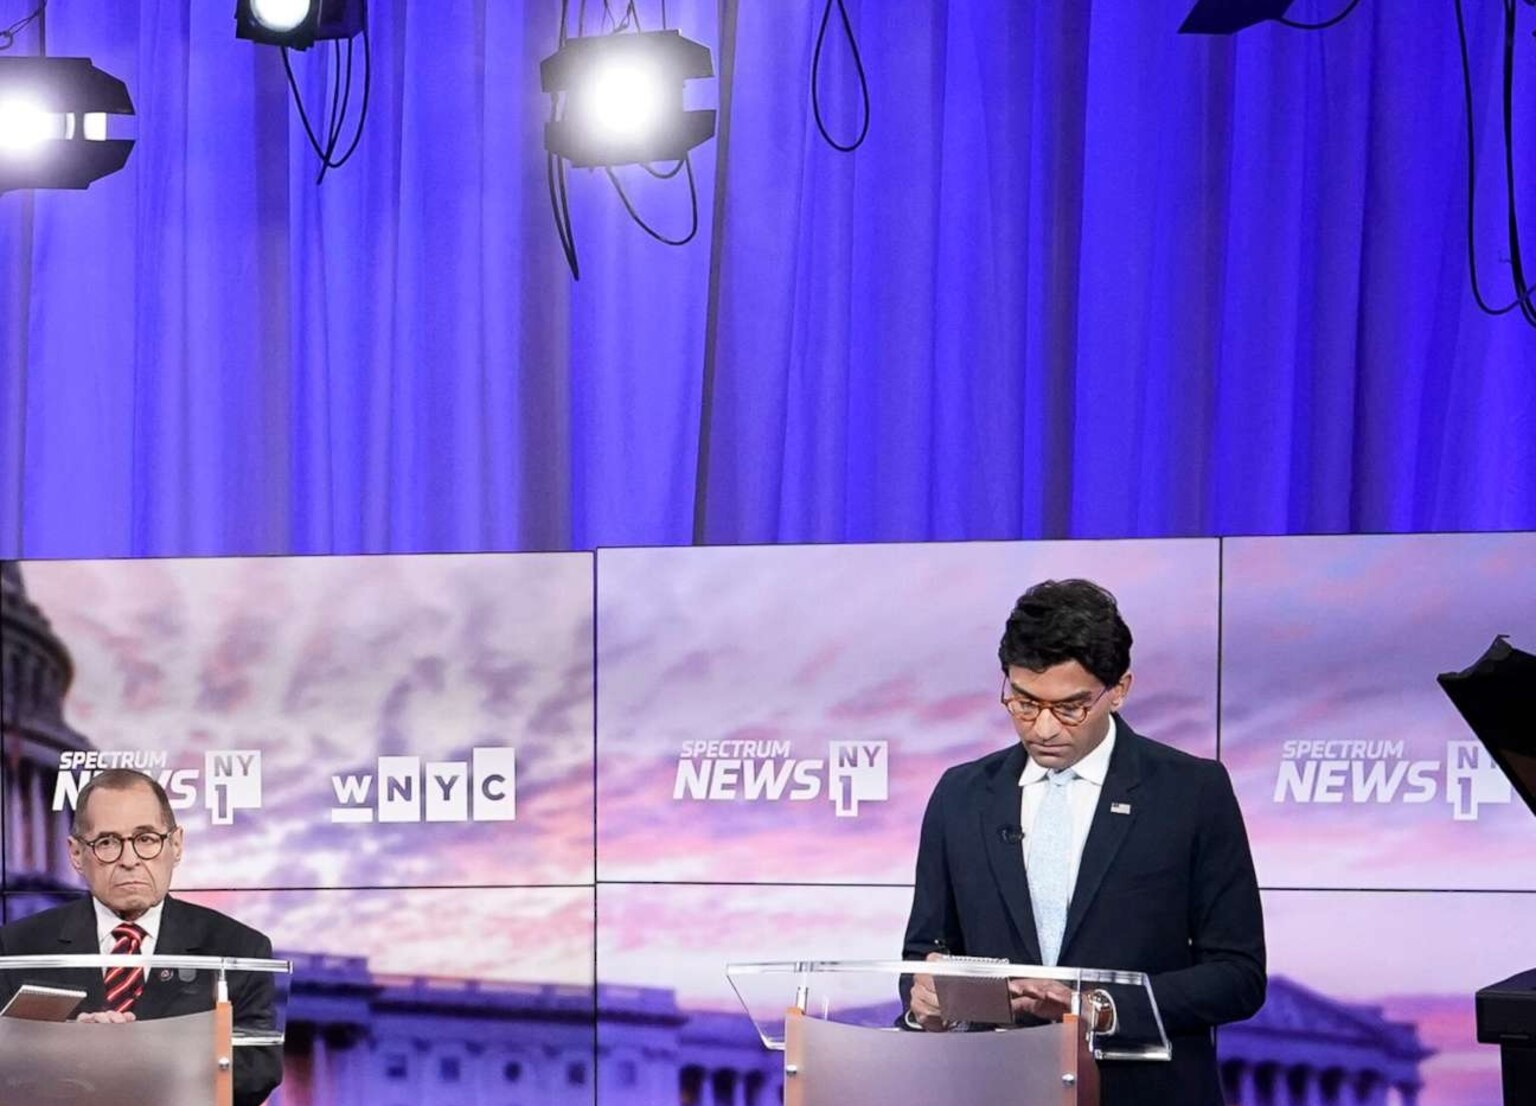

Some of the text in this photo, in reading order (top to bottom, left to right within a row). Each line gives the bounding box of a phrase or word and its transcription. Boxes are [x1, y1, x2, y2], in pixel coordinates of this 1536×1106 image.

[59, 751, 166, 770] SPECTRUM
[680, 740, 791, 758] SPECTRUM
[838, 745, 880, 768] NY
[1282, 740, 1405, 759] SPECTRUM
[215, 754, 254, 778] NY
[52, 769, 200, 811] NS
[672, 759, 824, 801] NEWS
[1273, 761, 1441, 804] NEWS
